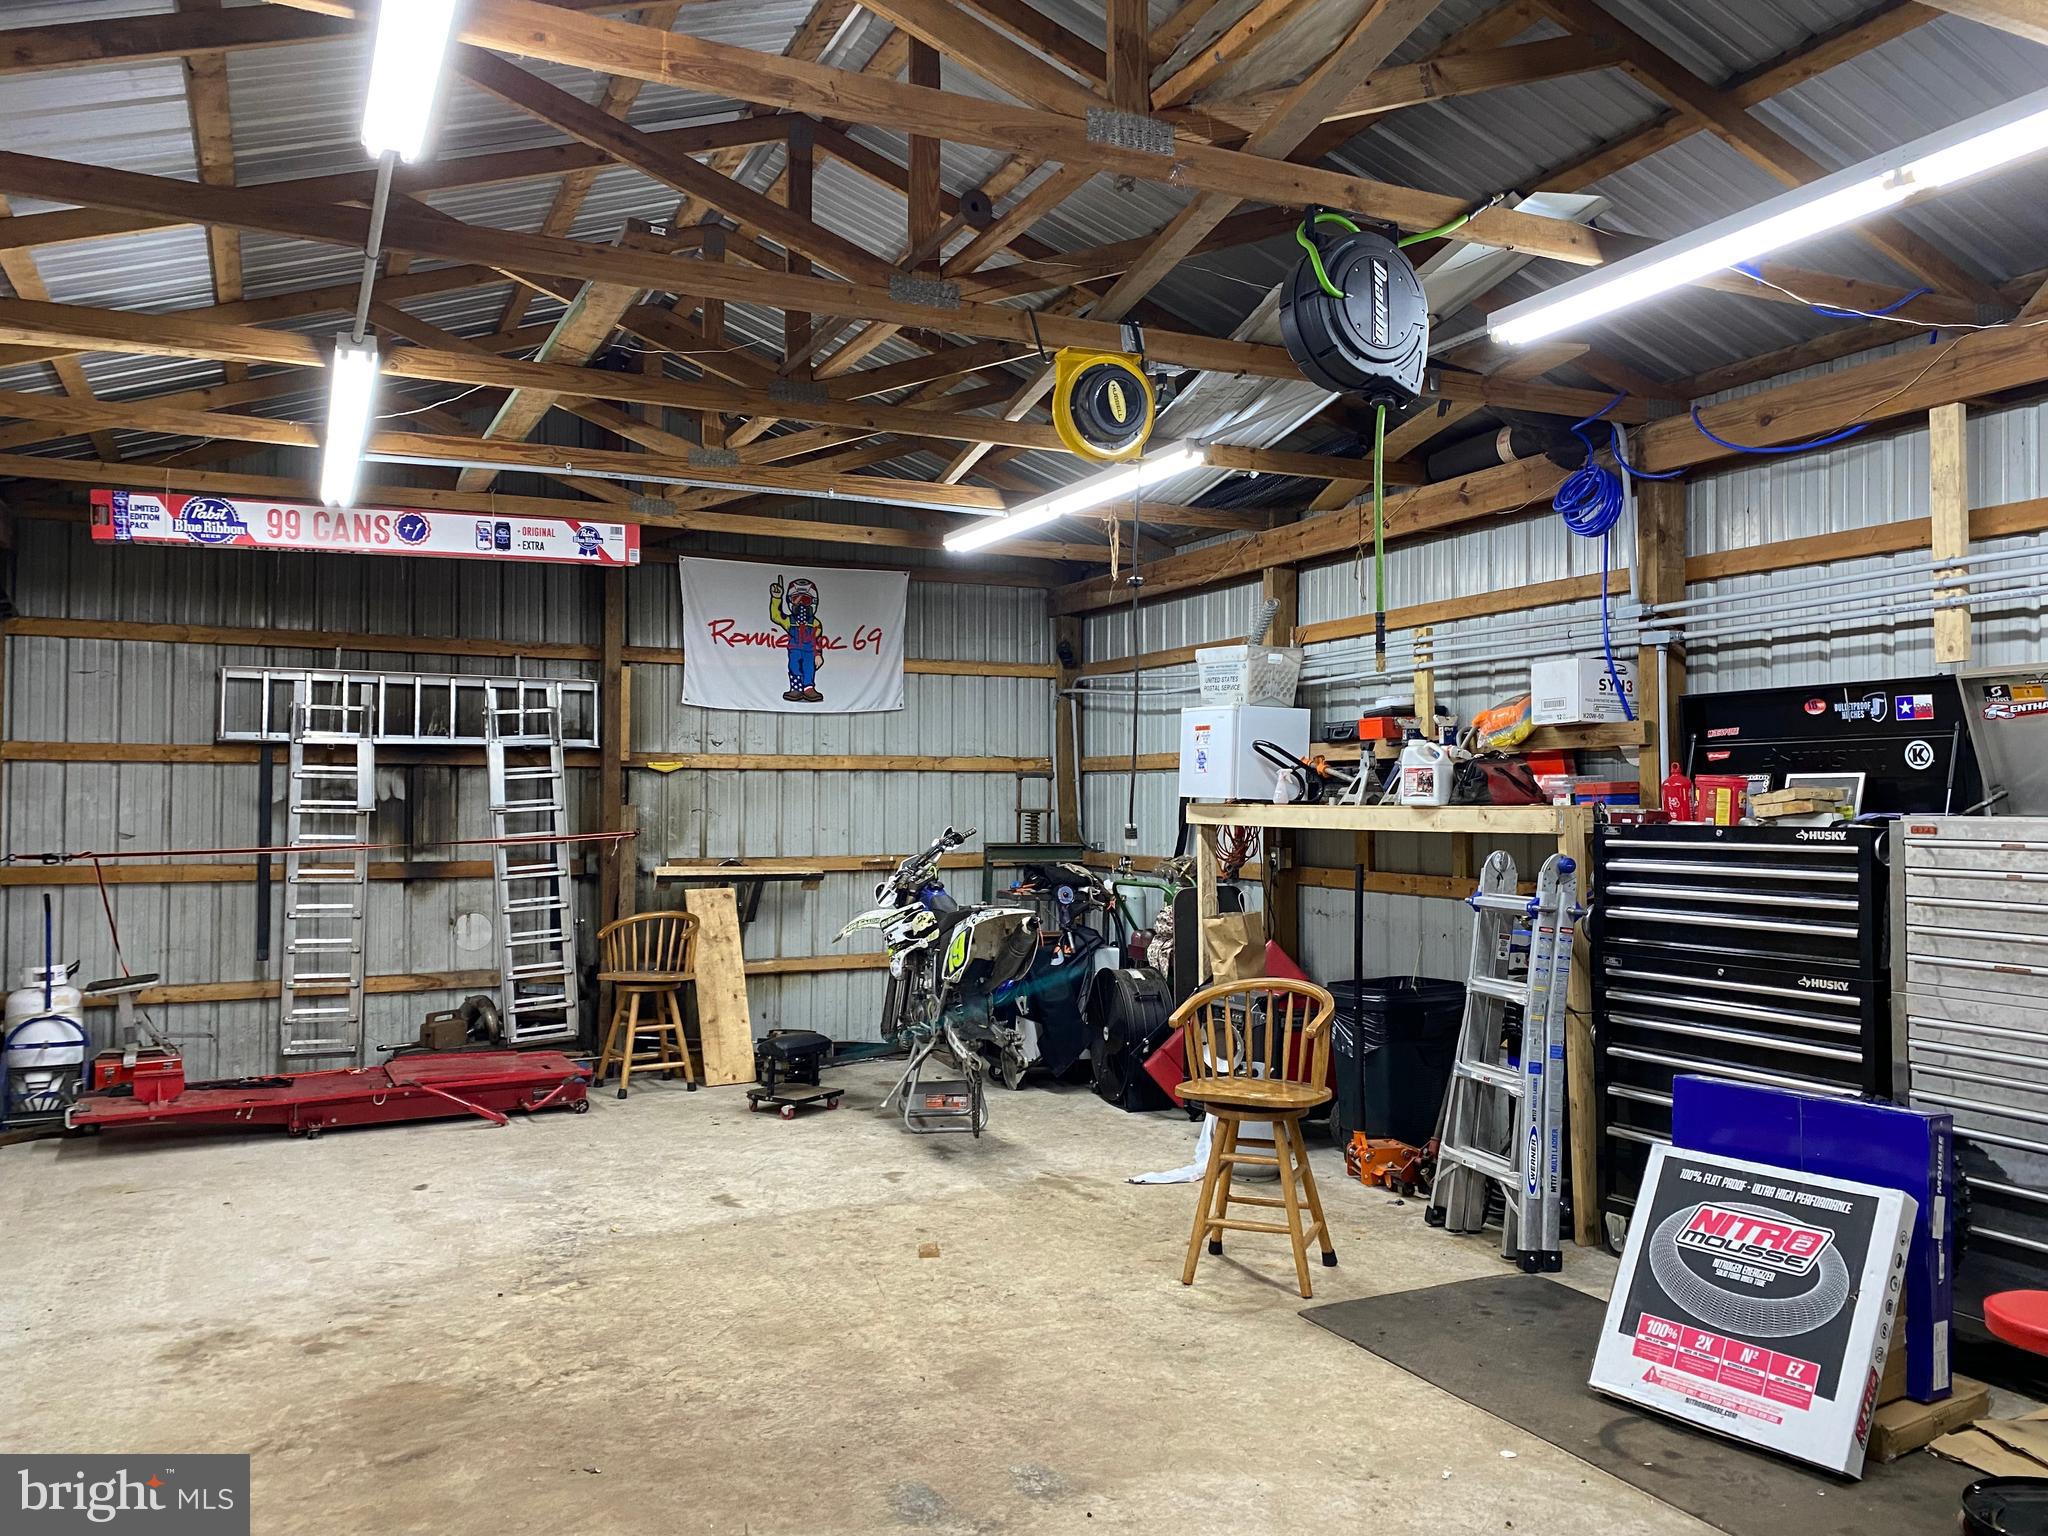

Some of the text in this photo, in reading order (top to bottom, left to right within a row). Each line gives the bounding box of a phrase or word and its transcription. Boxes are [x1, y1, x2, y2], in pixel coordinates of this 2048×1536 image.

[129, 504, 160, 513] LIMITED
[190, 502, 228, 520] Pabst
[129, 513, 160, 521] EDITION
[129, 521, 149, 529] PACK
[174, 519, 247, 535] Blue Ribbon
[266, 508, 390, 544] 99 CANS
[403, 522, 422, 538] +1
[522, 526, 556, 538] ORIGINAL
[522, 541, 545, 551] EXTRA
[707, 618, 791, 649] Ronnie
[853, 625, 883, 655] 69
[1204, 675, 1239, 684] UNITED STATES
[1220, 683, 1241, 691] SERVICE
[1808, 830, 1847, 841] HUSKY
[1811, 978, 1849, 991] HUSKY
[1551, 1129, 1559, 1153] LADDER
[1679, 1168, 1703, 1182] 100%
[1702, 1172, 1723, 1187] FLAT
[1721, 1177, 1748, 1192] PROOF
[1751, 1183, 1777, 1198] ULTRA
[1775, 1188, 1795, 1202] HIGH
[1794, 1191, 1854, 1214] PERFORMANCE
[1688, 1208, 1824, 1257] NITRO
[1711, 1258, 1777, 1282] NITROGEN ENERGIZED
[1646, 1319, 1678, 1340] 100%
[1694, 1334, 1715, 1352] 2X
[1785, 1360, 1806, 1379] EZ
